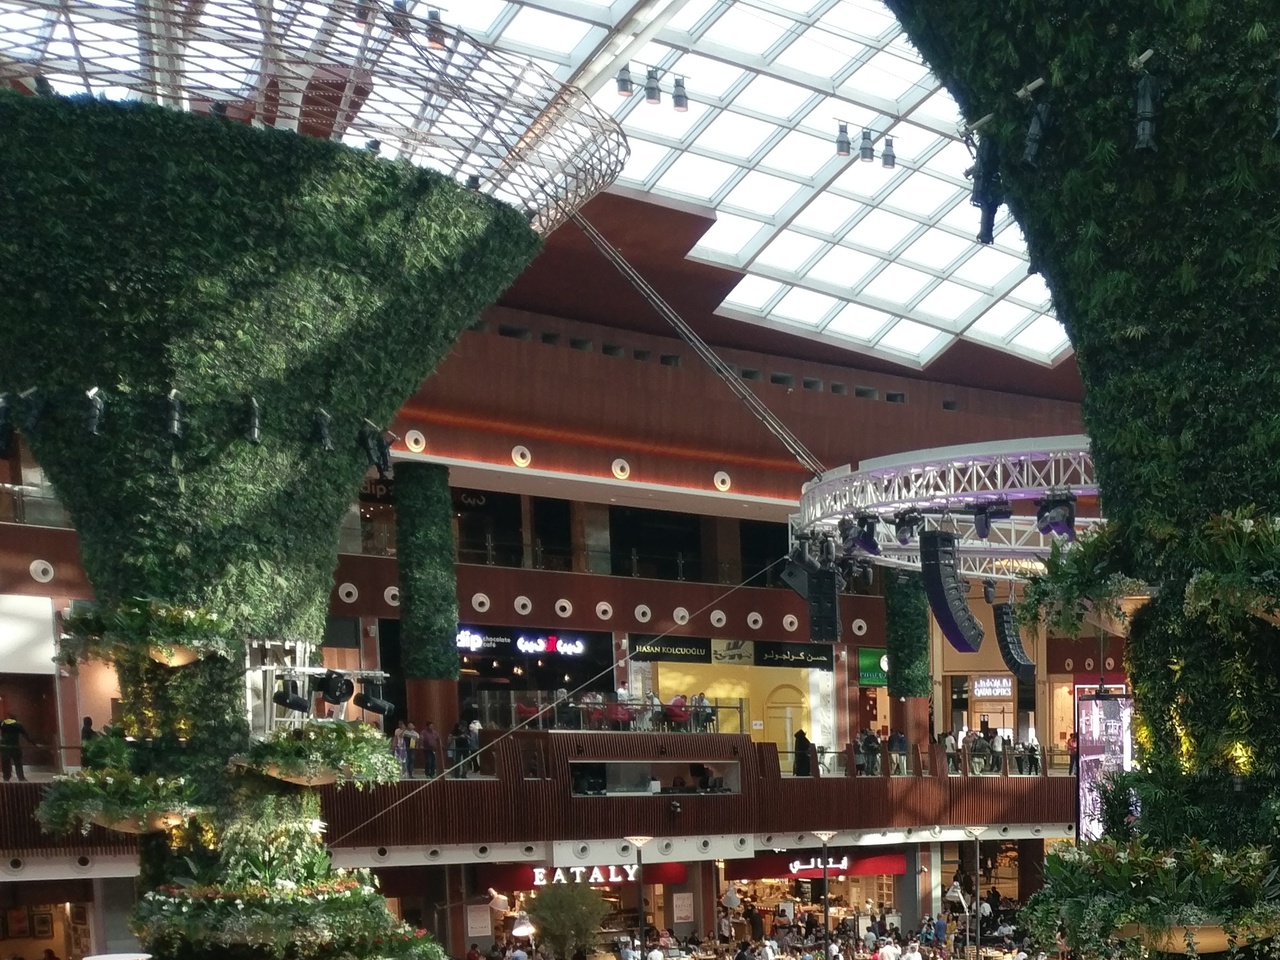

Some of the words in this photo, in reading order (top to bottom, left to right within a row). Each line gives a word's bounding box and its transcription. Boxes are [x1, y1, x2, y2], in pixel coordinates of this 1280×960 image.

[456, 630, 483, 651] dip
[482, 636, 511, 644] chocolate
[635, 644, 661, 653] HASAN
[532, 864, 639, 886] EATALY
